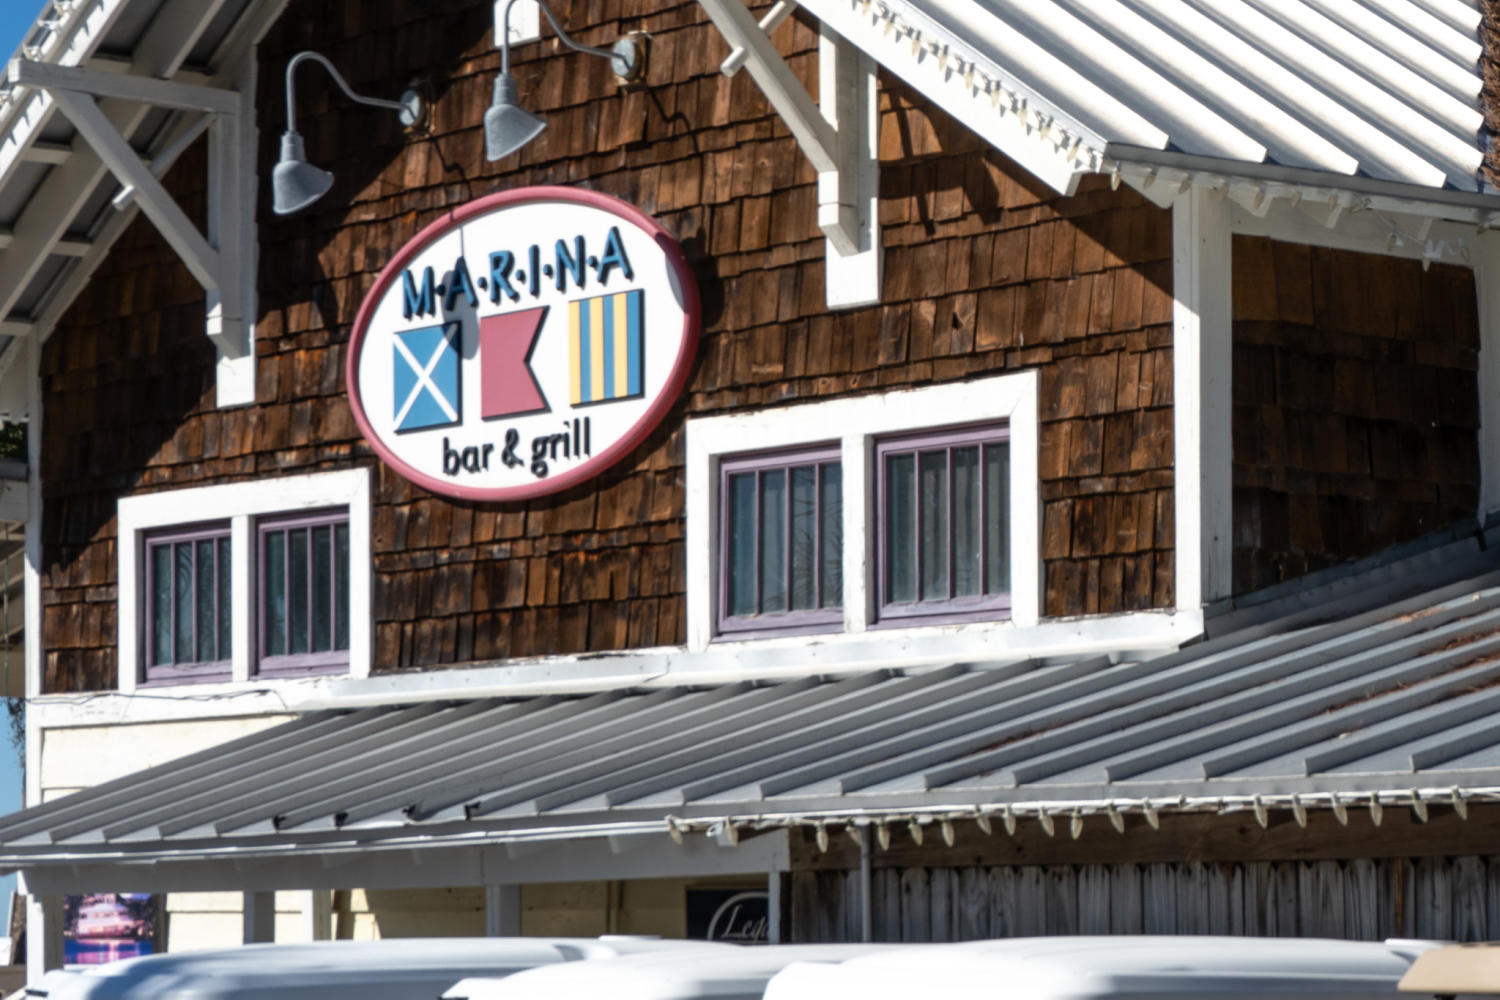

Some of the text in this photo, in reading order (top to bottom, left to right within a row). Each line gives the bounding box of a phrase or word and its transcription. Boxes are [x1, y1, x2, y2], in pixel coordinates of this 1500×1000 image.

[443, 417, 591, 478] bar & grill
